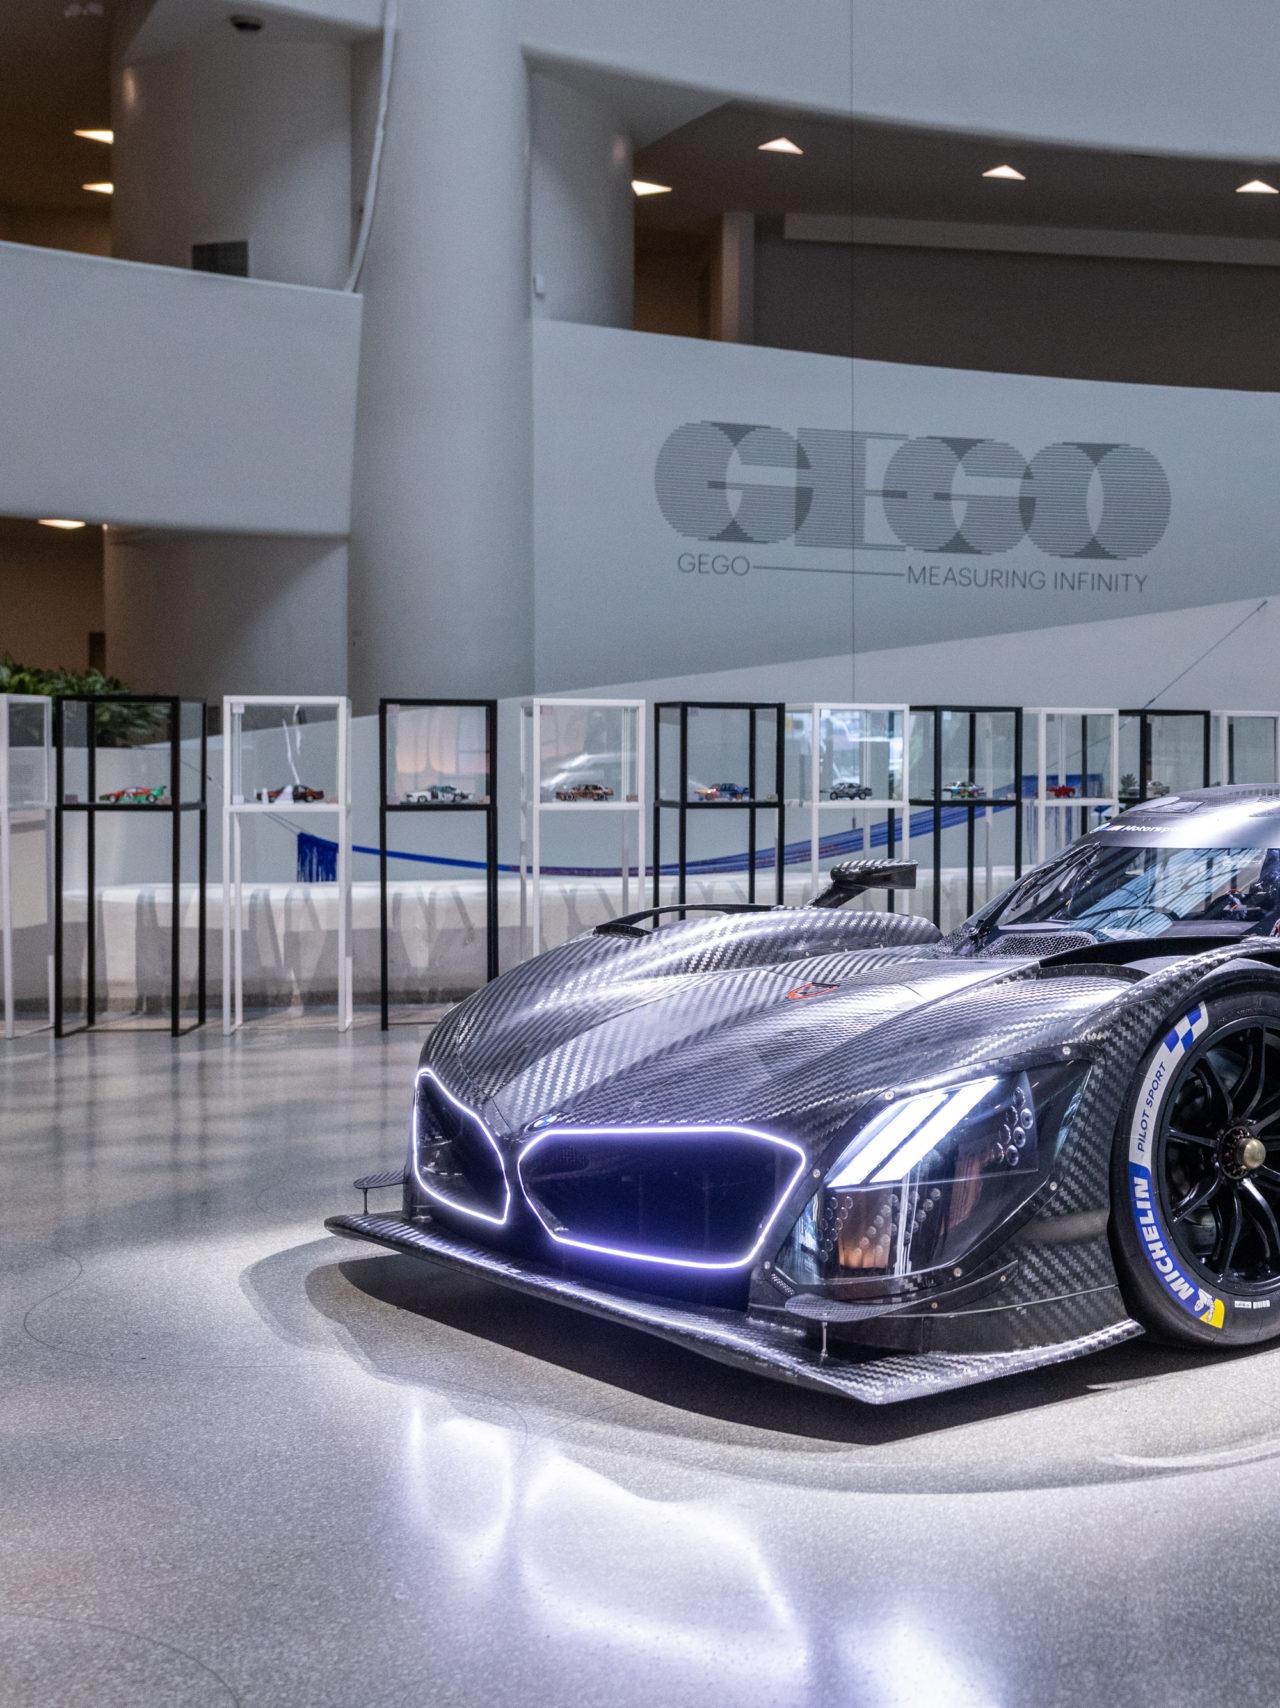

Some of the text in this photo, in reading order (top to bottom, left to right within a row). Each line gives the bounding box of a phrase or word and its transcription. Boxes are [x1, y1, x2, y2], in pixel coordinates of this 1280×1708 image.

[654, 420, 1172, 560] GEGO
[677, 553, 1149, 593] GEGO MEASURING INFINITY
[1137, 1061, 1168, 1153] PILOT SPORT
[1133, 1176, 1196, 1301] MICHELIN
